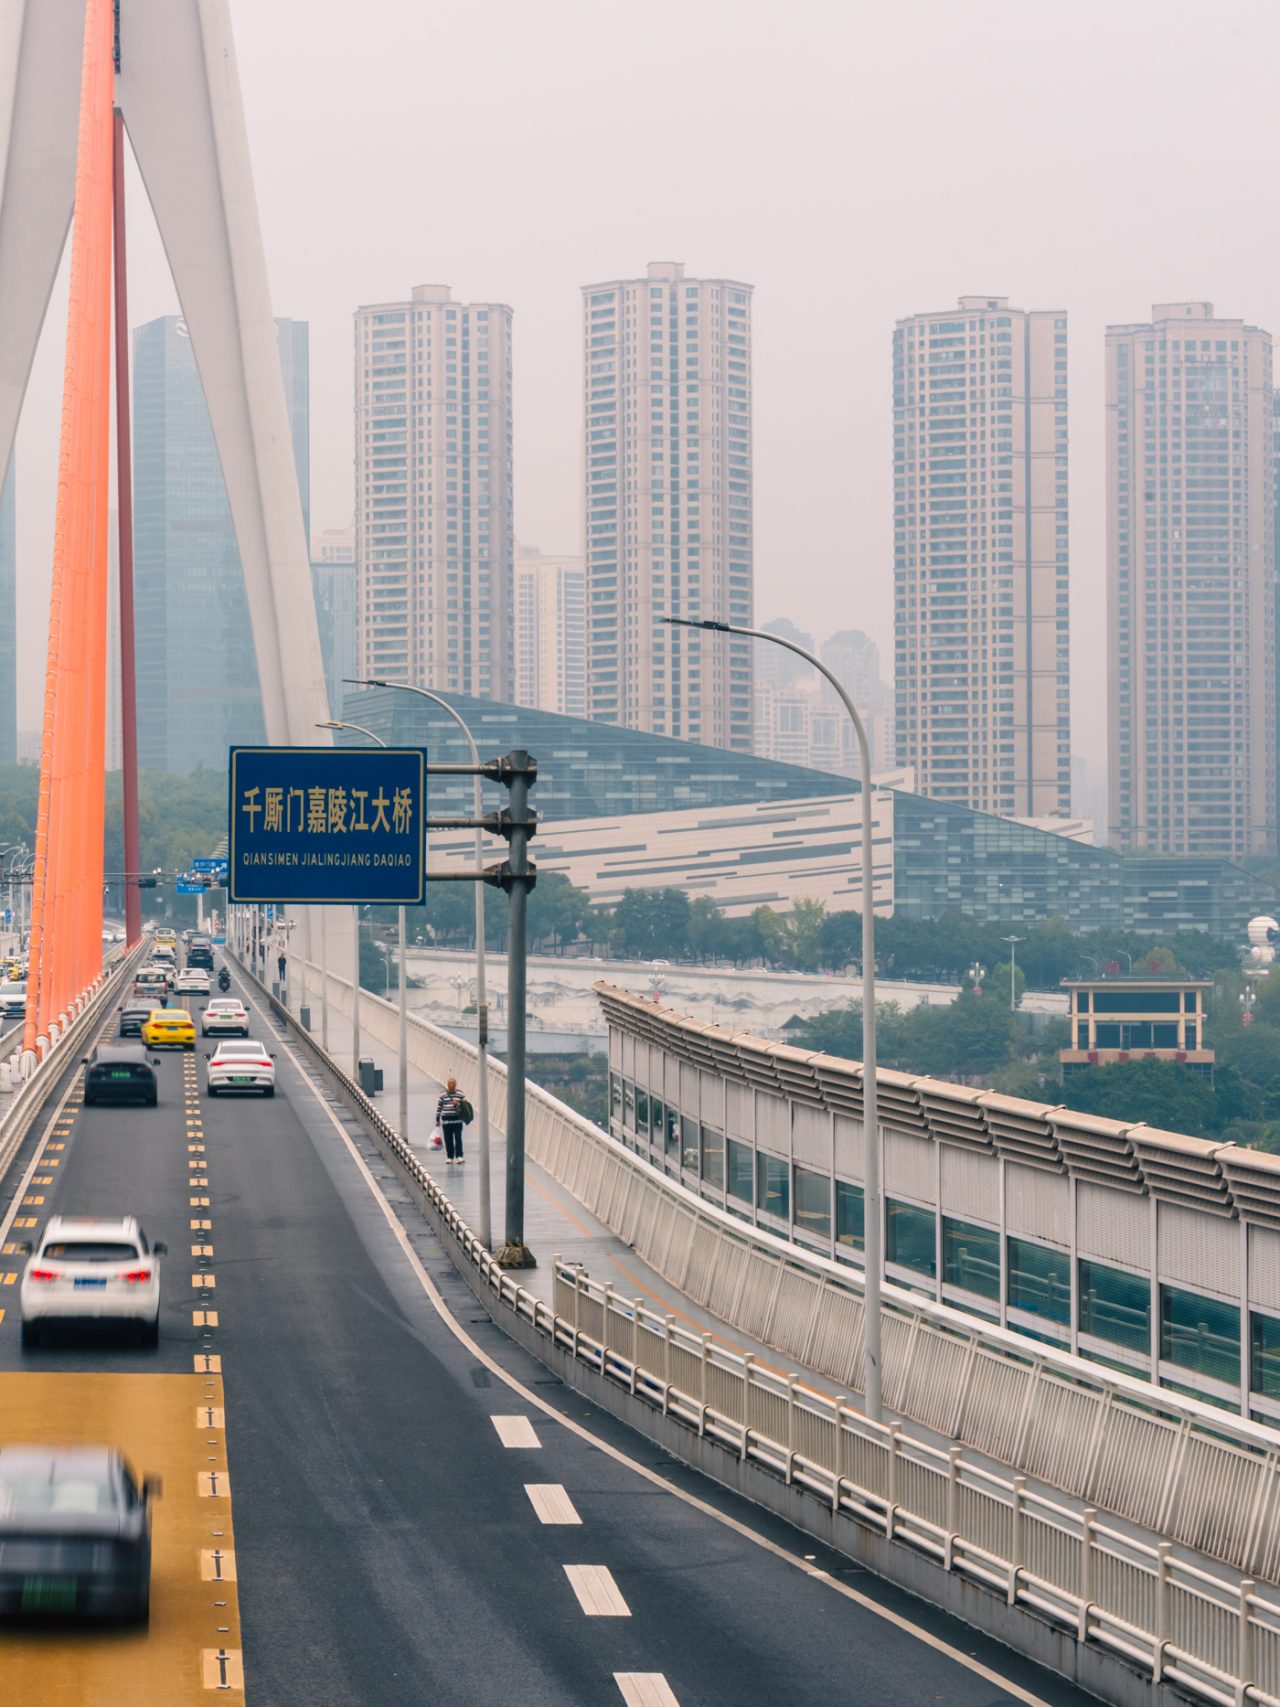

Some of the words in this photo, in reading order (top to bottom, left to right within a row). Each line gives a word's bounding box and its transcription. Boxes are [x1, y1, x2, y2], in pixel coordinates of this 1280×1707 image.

[241, 785, 413, 834] 千厮门嘉陵江大桥
[243, 852, 299, 866] QIANSIMEN
[301, 853, 371, 867] JIALINGJIANG
[373, 853, 412, 867] DAQIAO
